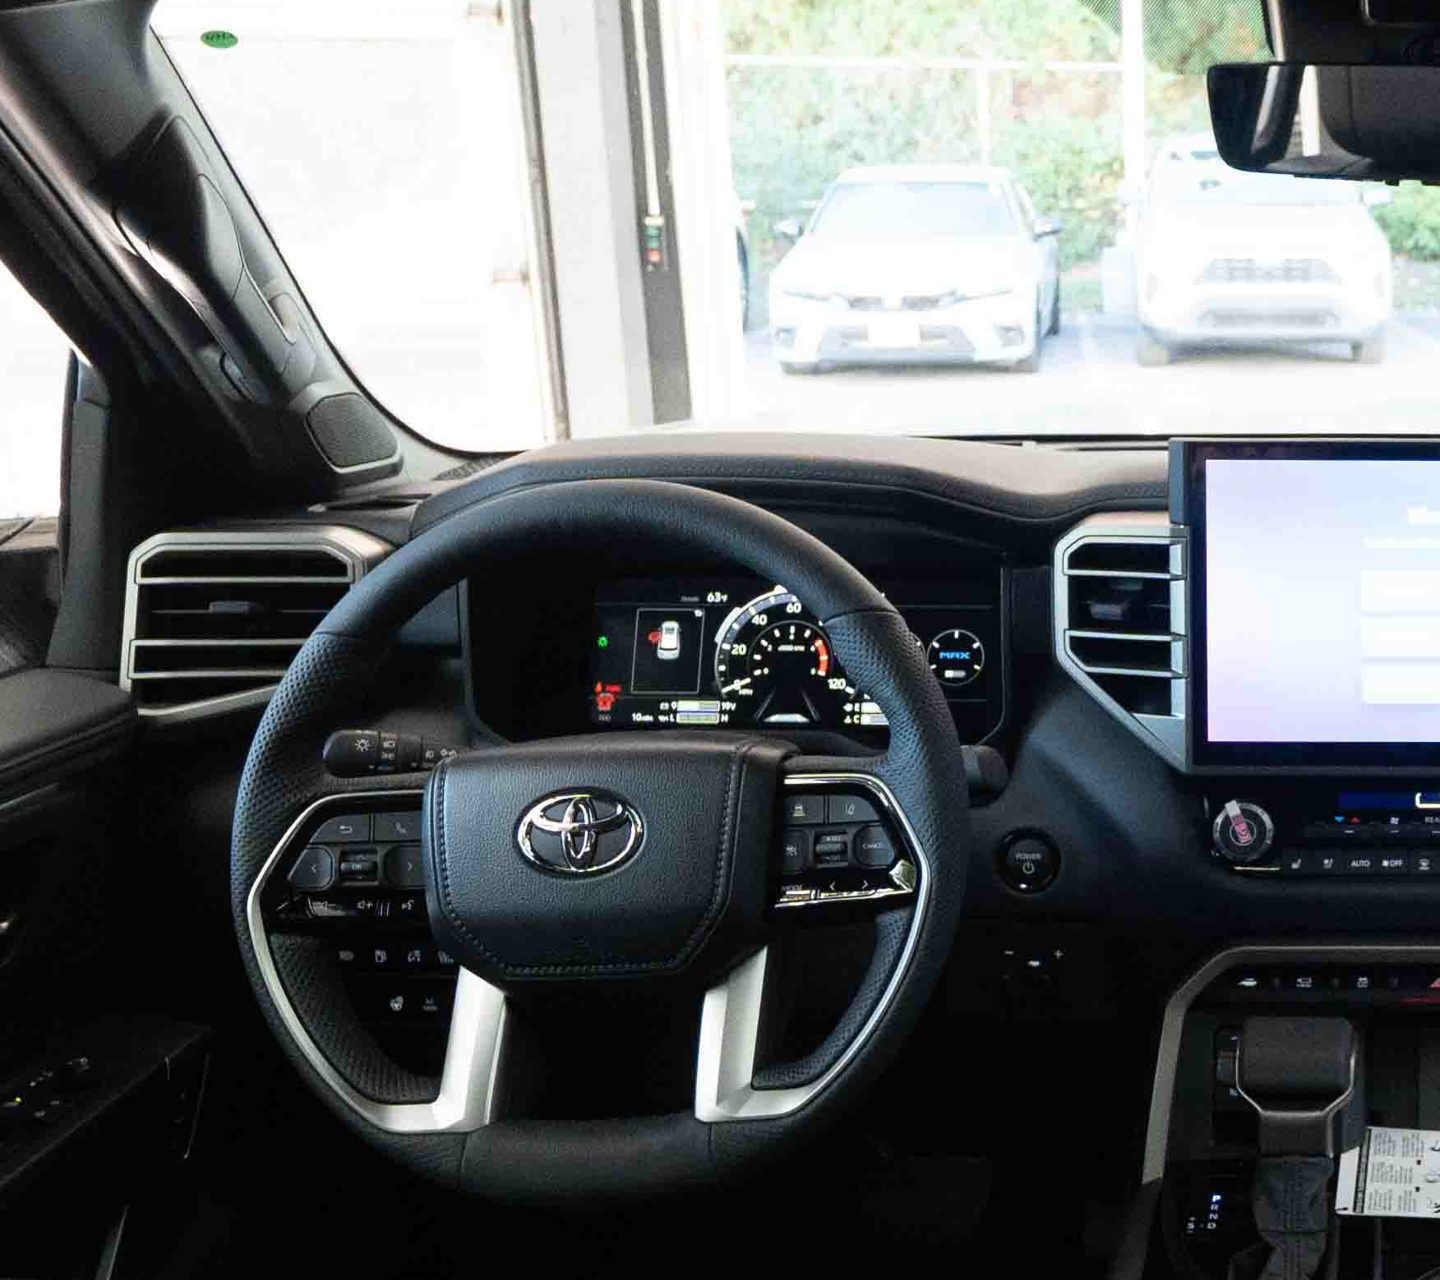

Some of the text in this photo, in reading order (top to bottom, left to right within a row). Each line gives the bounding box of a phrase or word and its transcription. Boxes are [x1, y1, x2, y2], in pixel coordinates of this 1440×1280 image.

[786, 603, 802, 614] 60
[751, 614, 768, 626] 40
[731, 644, 747, 655] 20
[939, 651, 971, 659] MAX
[827, 678, 847, 690] 120
[1350, 859, 1371, 867] AUTO
[1389, 859, 1404, 867] OFF
[1212, 1194, 1221, 1202] P
